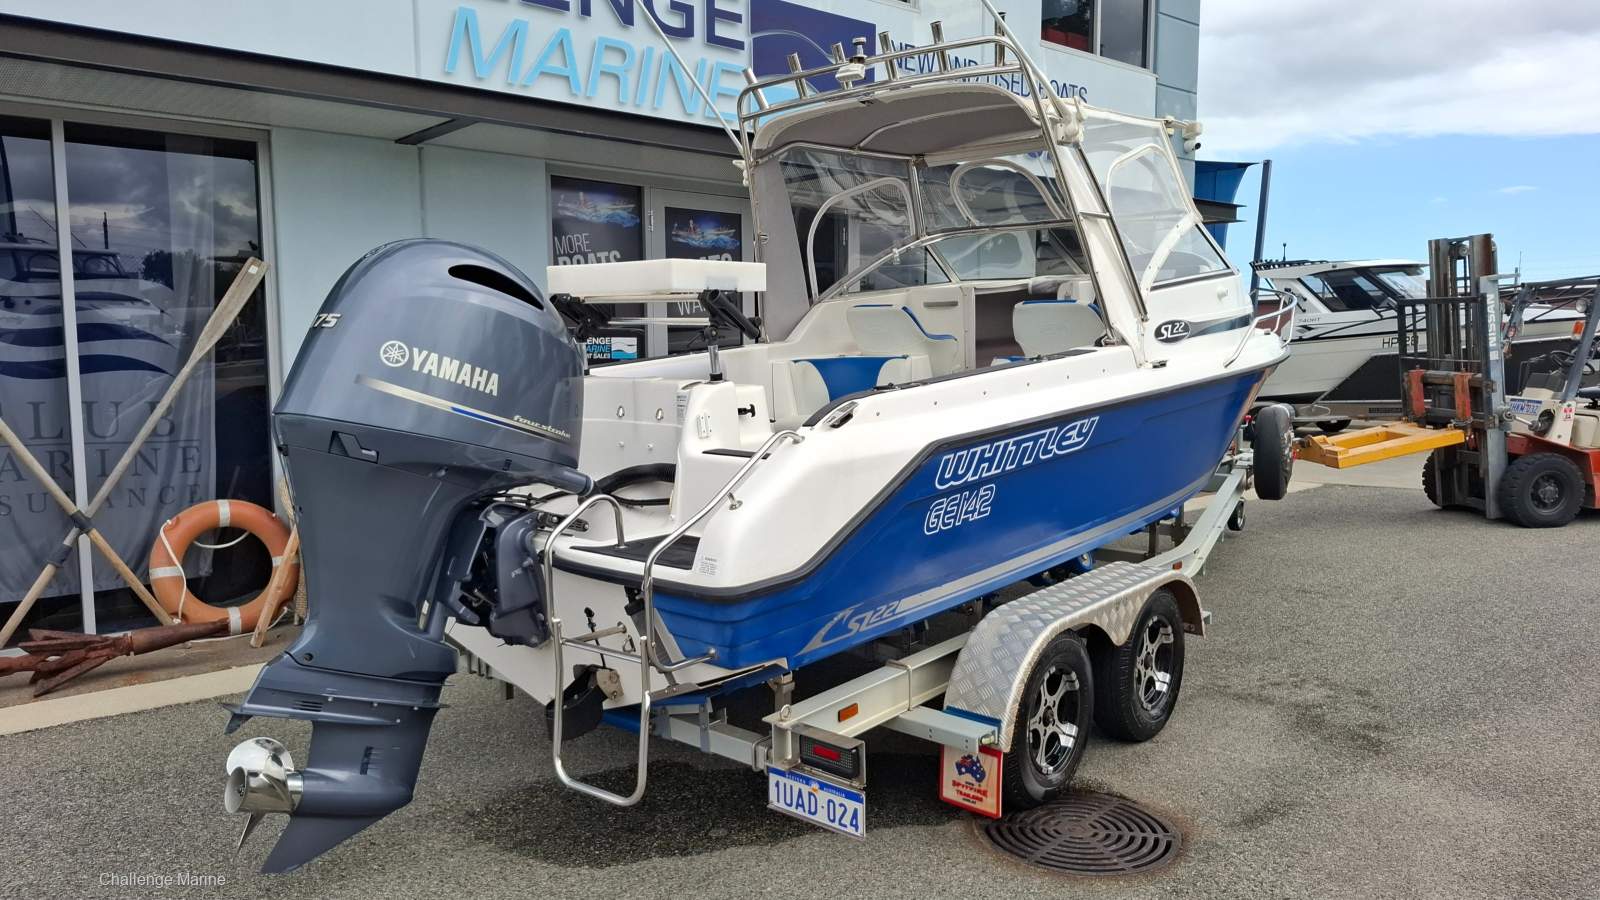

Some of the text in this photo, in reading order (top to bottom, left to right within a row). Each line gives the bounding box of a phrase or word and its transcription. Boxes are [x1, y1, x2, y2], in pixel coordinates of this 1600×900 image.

[445, 6, 748, 121] MARINE
[891, 39, 938, 75] NEW
[554, 233, 592, 255] MORE
[1486, 294, 1497, 347] NISSAN
[412, 347, 499, 396] YAMAHA
[935, 415, 1099, 489] WHITTLEY
